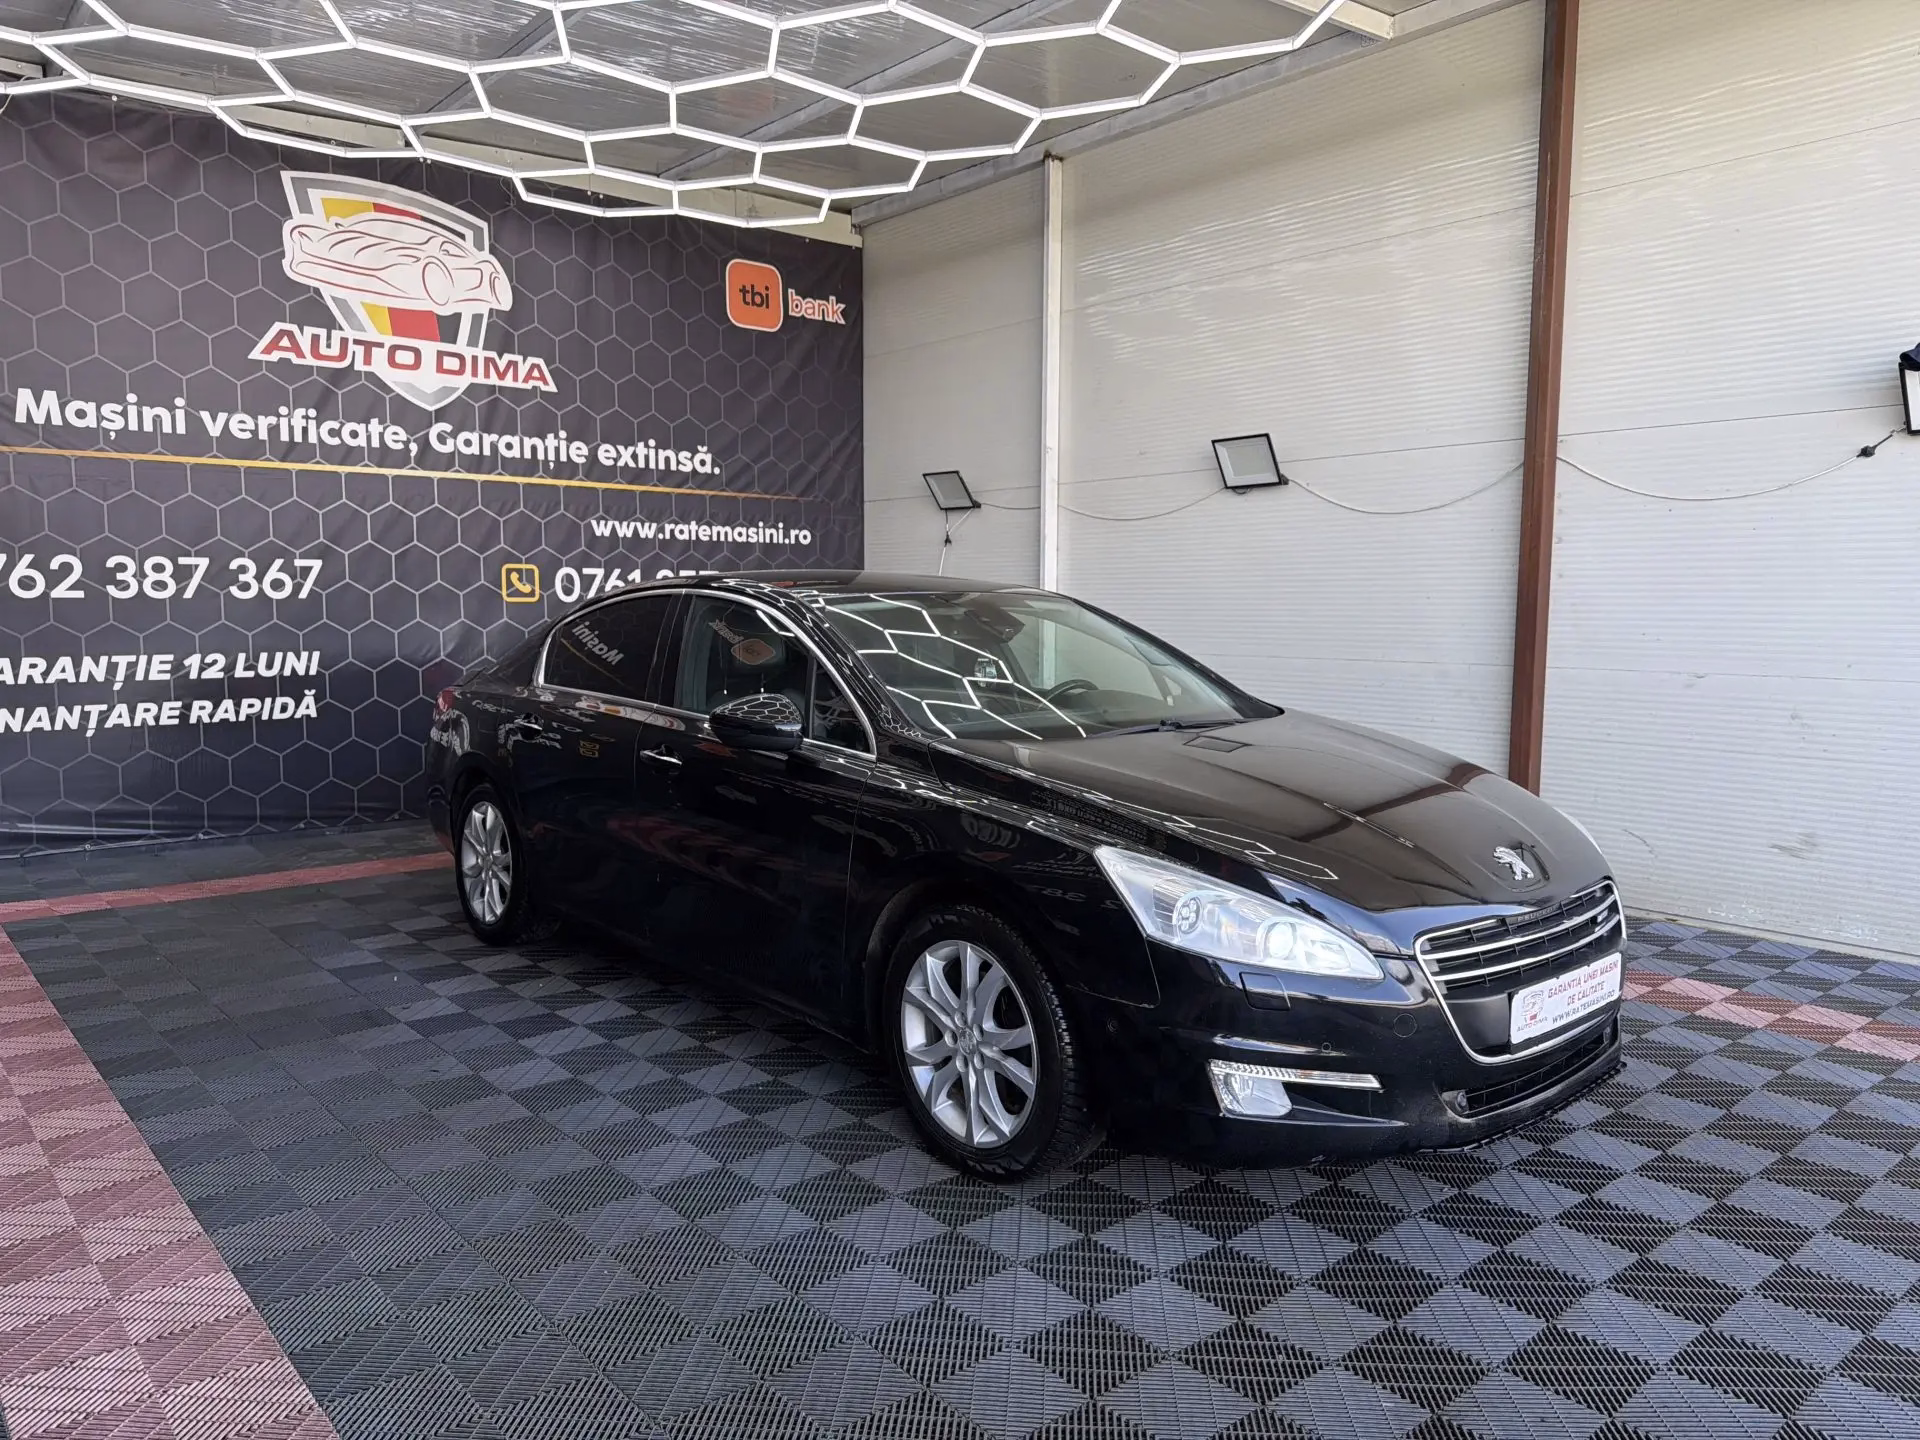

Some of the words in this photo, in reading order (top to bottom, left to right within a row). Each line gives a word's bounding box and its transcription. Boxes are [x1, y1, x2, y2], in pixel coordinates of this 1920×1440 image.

[739, 283, 770, 309] tbi
[788, 288, 846, 325] bank
[259, 327, 422, 371] AUTO
[436, 349, 550, 387] DIMA
[15, 388, 186, 440] Mașini
[200, 405, 419, 456] verificate,
[428, 421, 589, 470] Garanție
[598, 438, 721, 475] extinsă.
[591, 519, 812, 546] www.ratemasini.ro
[0, 553, 85, 599] 62
[105, 555, 210, 599] 387
[228, 558, 323, 600] 367
[183, 653, 224, 680] 12
[234, 651, 321, 679] LUNI
[189, 689, 319, 724] RAPIDĂ
[1567, 993, 1577, 1006] DE
[1577, 980, 1606, 1001] CALITATE
